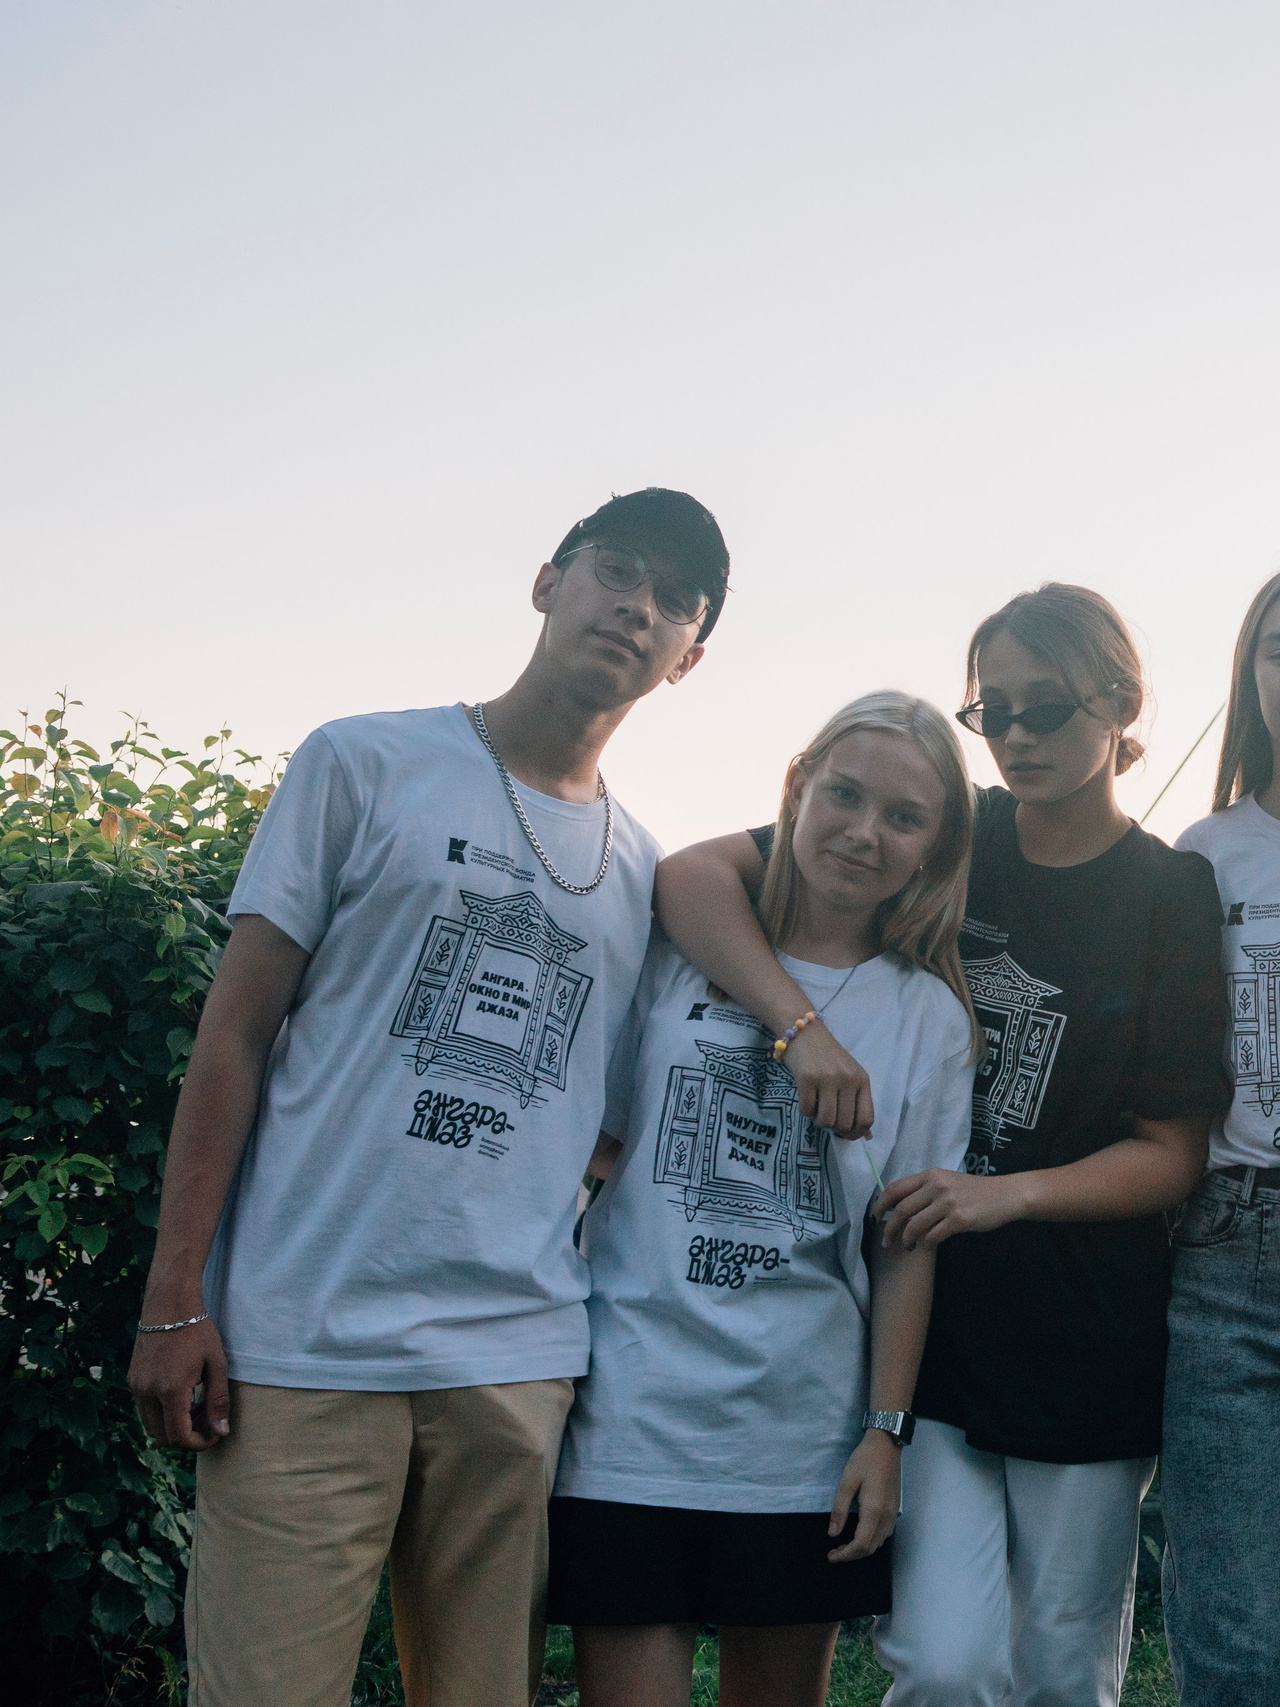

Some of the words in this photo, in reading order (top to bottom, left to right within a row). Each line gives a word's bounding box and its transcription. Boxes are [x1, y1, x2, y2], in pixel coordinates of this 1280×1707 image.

[481, 971, 524, 992] АНГАРА
[469, 983, 500, 999] ОКНО
[501, 991, 511, 1002] В
[511, 994, 531, 1010] МИР
[476, 1000, 519, 1021] ДЖАЗА
[726, 1111, 777, 1138] ВНУТРИ
[727, 1128, 772, 1155] ИГРАЕТ
[728, 1146, 765, 1171] ДЖАЗ
